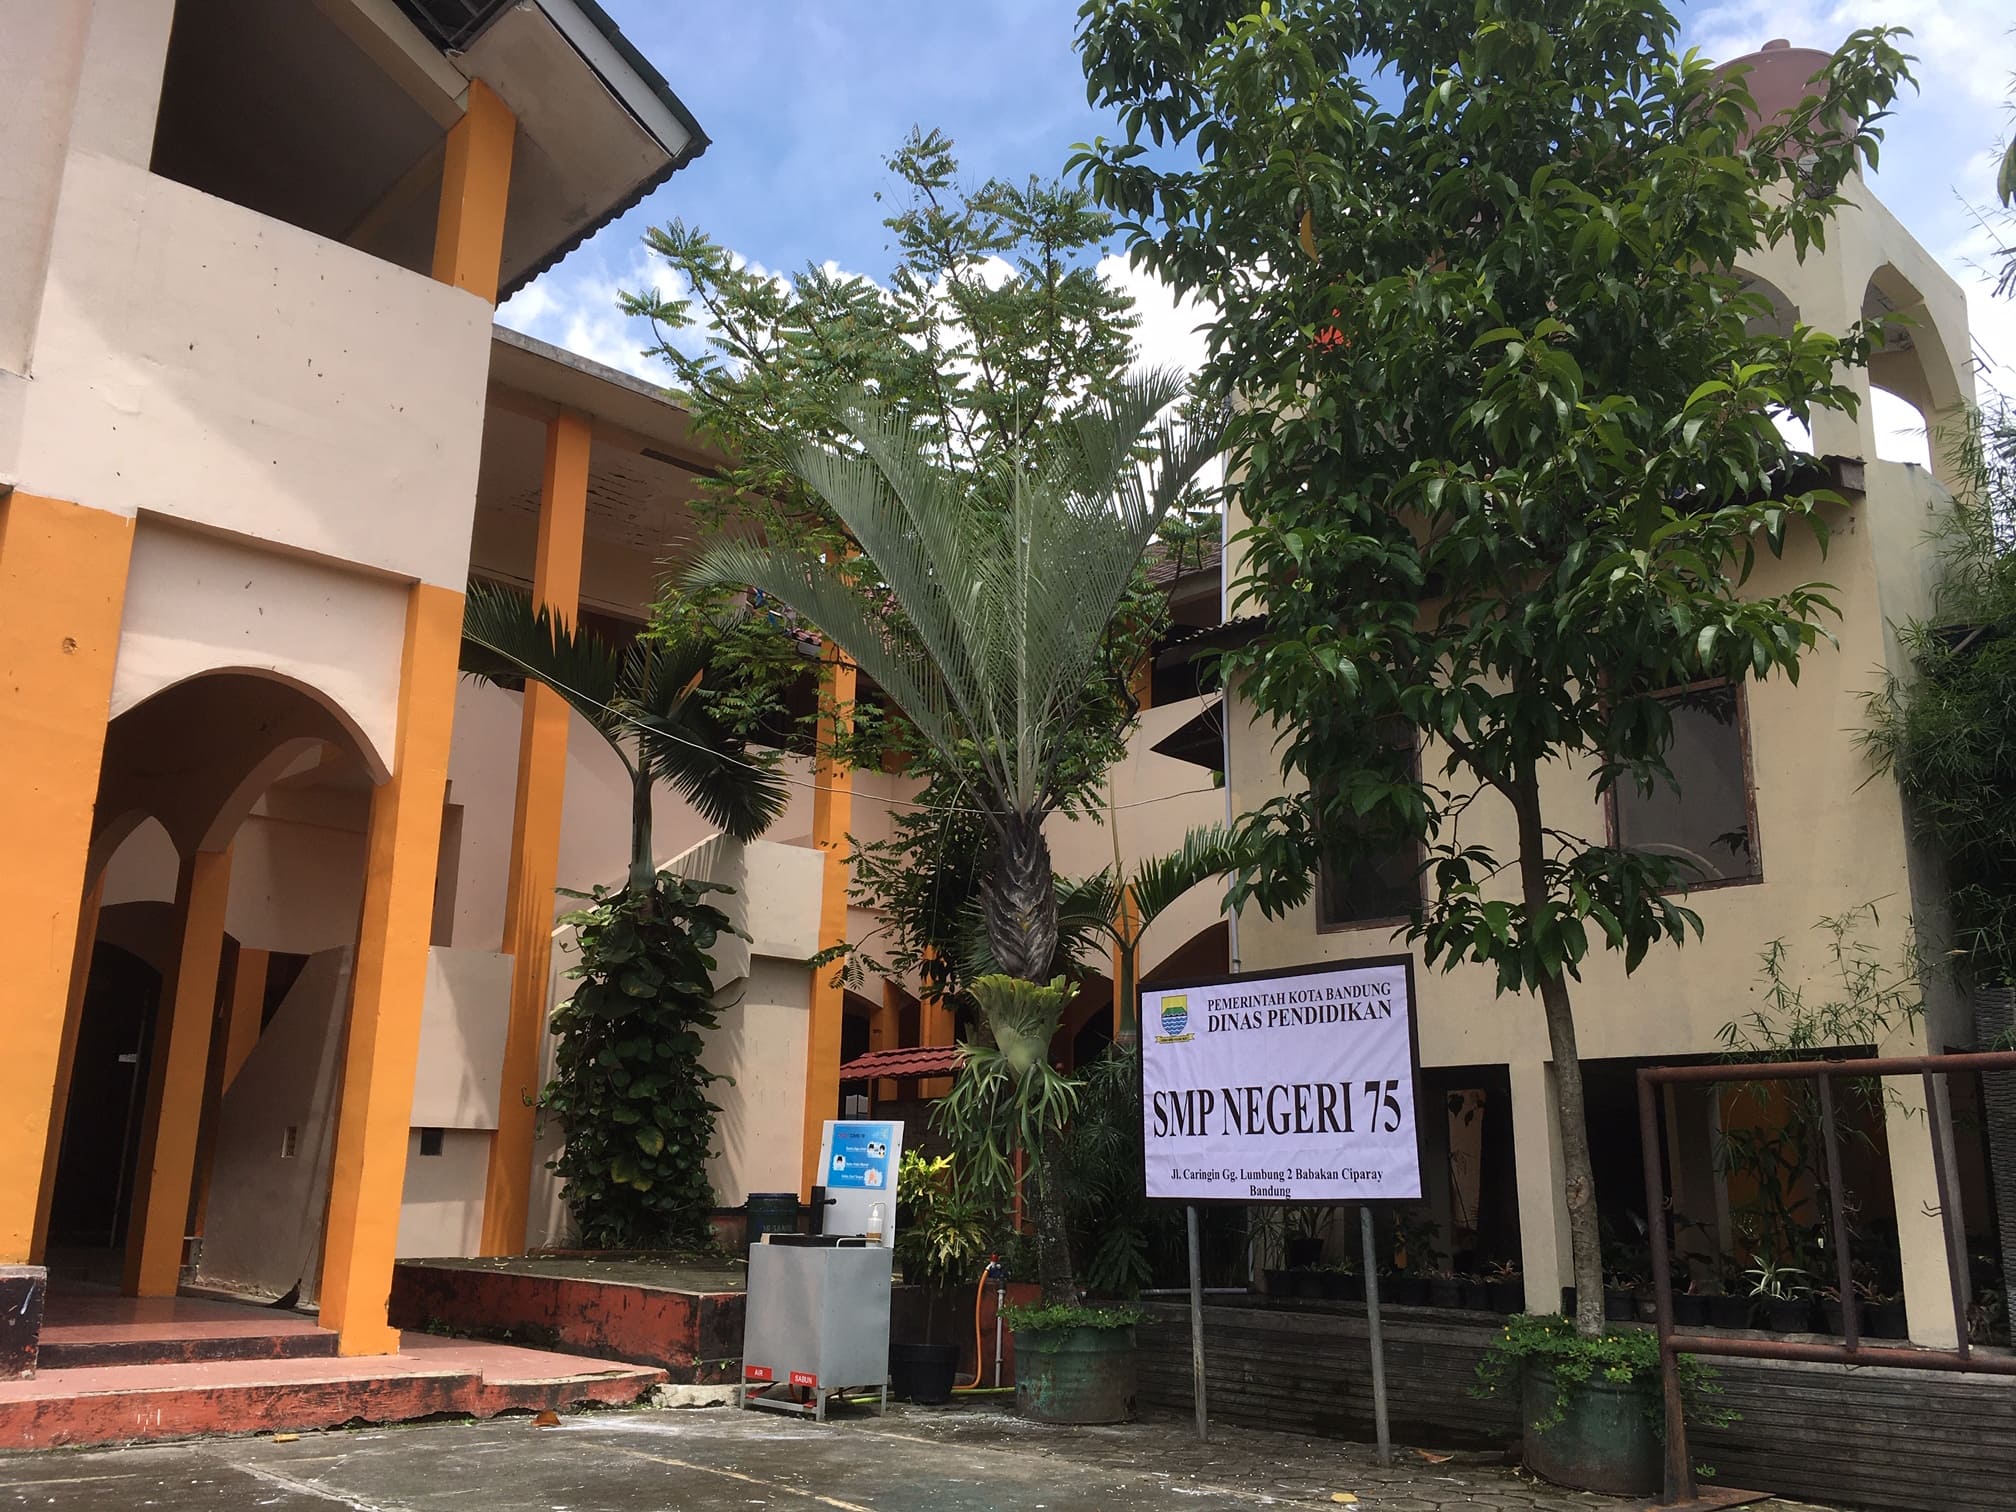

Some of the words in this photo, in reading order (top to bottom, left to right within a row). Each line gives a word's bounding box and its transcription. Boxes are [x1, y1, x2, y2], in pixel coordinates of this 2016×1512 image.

[1208, 992, 1285, 1011] PEMERINTAH
[1289, 989, 1324, 1004] KOTA
[1326, 982, 1391, 1001] BANDUNG
[1208, 1012, 1262, 1032] DINAS
[1268, 1000, 1392, 1027] PENDIDIKAN
[1153, 1089, 1215, 1138] SMP
[1222, 1082, 1354, 1136] NEGERI
[1364, 1080, 1401, 1132] 75
[1171, 1169, 1181, 1180] Jl.
[1183, 1169, 1220, 1181] Caringin
[1222, 1169, 1238, 1182] Gg.
[1240, 1169, 1284, 1182] Lumbung
[1287, 1169, 1293, 1180] 2
[1295, 1168, 1339, 1180] Babakan
[1341, 1168, 1383, 1183] Ciparay
[1250, 1185, 1291, 1199] Bandung
[795, 1375, 812, 1384] SABUN
